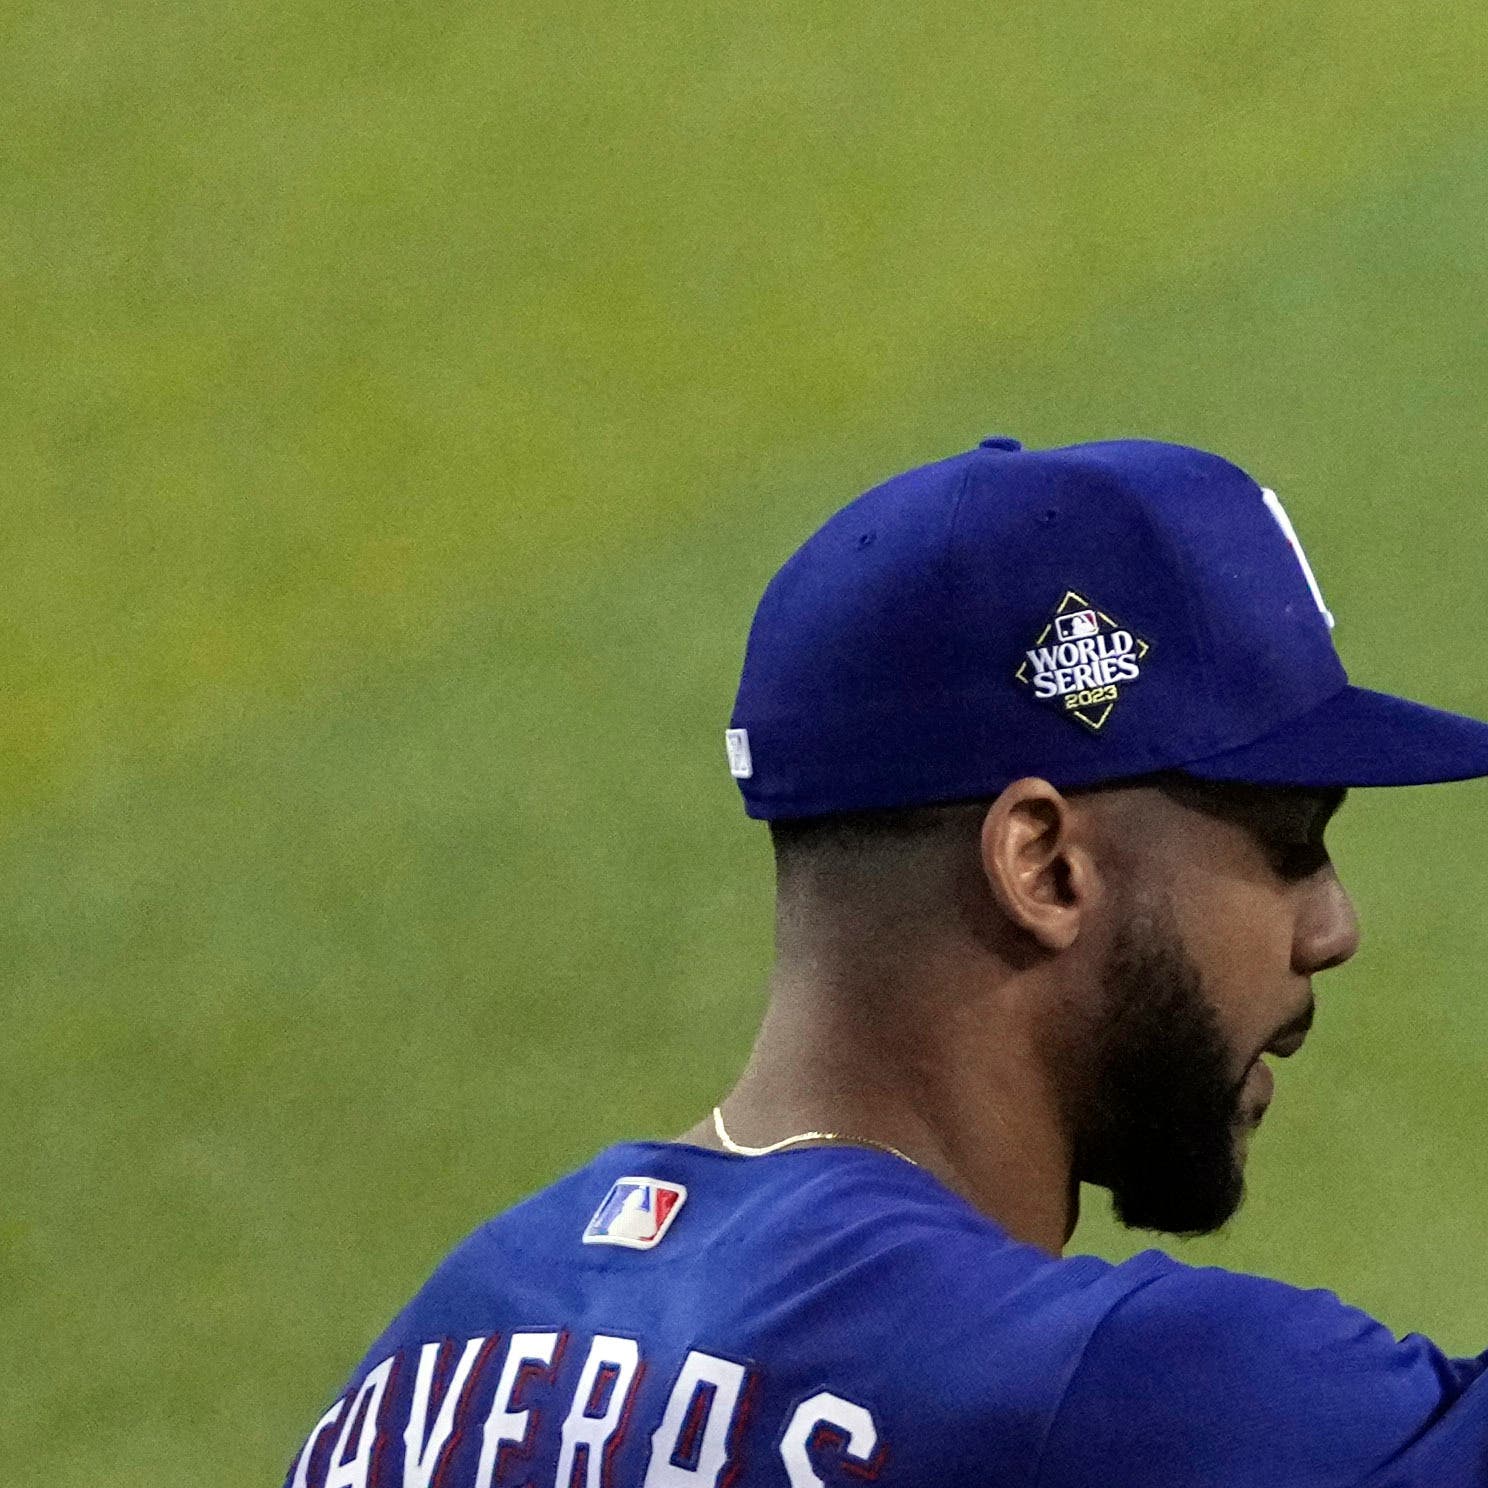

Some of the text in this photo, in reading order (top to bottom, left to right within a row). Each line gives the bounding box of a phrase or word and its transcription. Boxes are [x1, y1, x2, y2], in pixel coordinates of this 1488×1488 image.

[1026, 630, 1134, 674] WORLD
[1032, 653, 1140, 698] SERIES
[1064, 685, 1118, 709] 2023
